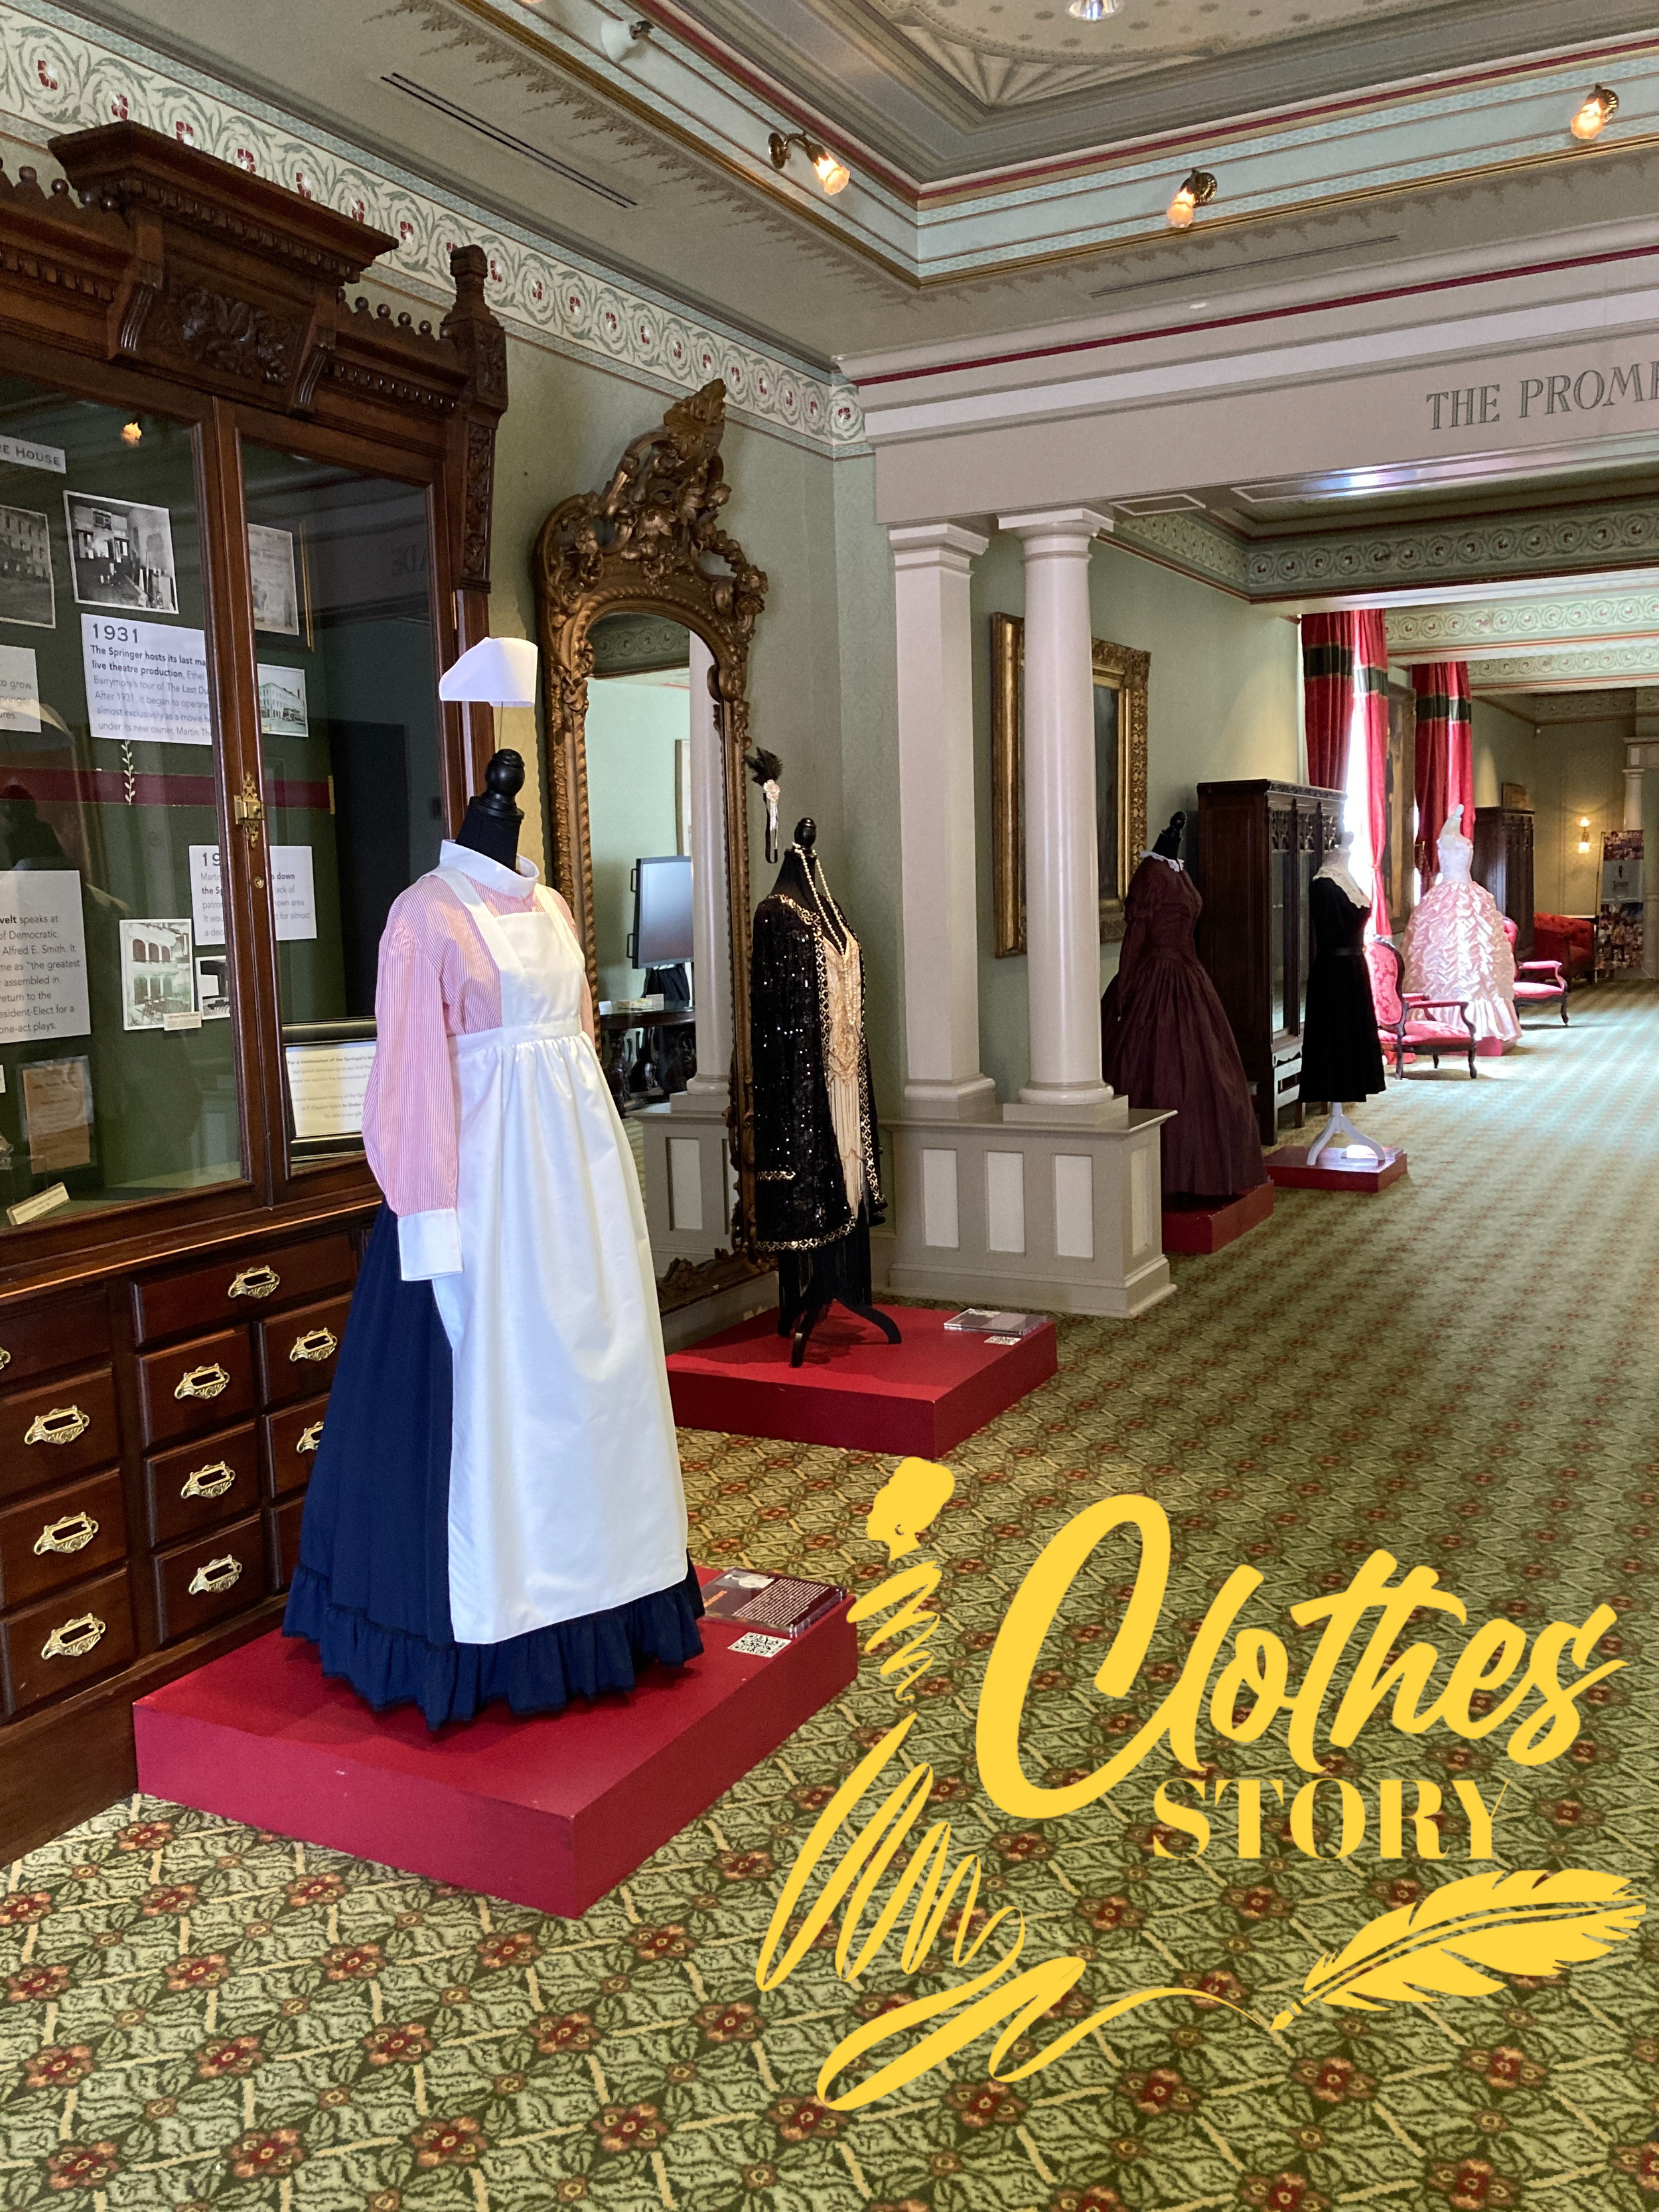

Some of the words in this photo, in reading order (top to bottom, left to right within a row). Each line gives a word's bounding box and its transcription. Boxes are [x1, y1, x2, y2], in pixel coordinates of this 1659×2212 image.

[1425, 384, 1500, 430] THE
[16, 446, 60, 467] HOUSE
[93, 623, 138, 643] 1931
[90, 644, 106, 654] The
[109, 647, 143, 660] Springer
[145, 651, 166, 662] hosts
[167, 654, 177, 663] its
[179, 654, 192, 665] last
[92, 660, 106, 670] live
[109, 662, 138, 673] theatre
[186, 670, 204, 680] Ethel
[10, 681, 31, 690] grow
[94, 675, 138, 688] Barrymore's
[157, 682, 164, 691] of
[167, 683, 180, 692] The
[182, 685, 196, 694] Last
[95, 691, 113, 701] After
[139, 694, 145, 703] it
[146, 695, 169, 707] began
[181, 700, 208, 709] operate
[97, 706, 124, 717] almost
[125, 710, 164, 721] exclusively
[98, 721, 121, 731] under
[177, 726, 199, 737] Martin
[19, 914, 48, 926] speaks
[291, 911, 311, 920] almost
[9, 930, 58, 940] Democratic
[2, 945, 29, 955] Alfred
[70, 942, 76, 952] It
[47, 960, 81, 971] greatest
[4, 975, 50, 987] assembled
[38, 991, 52, 999] the
[56, 1004, 67, 1013] for
